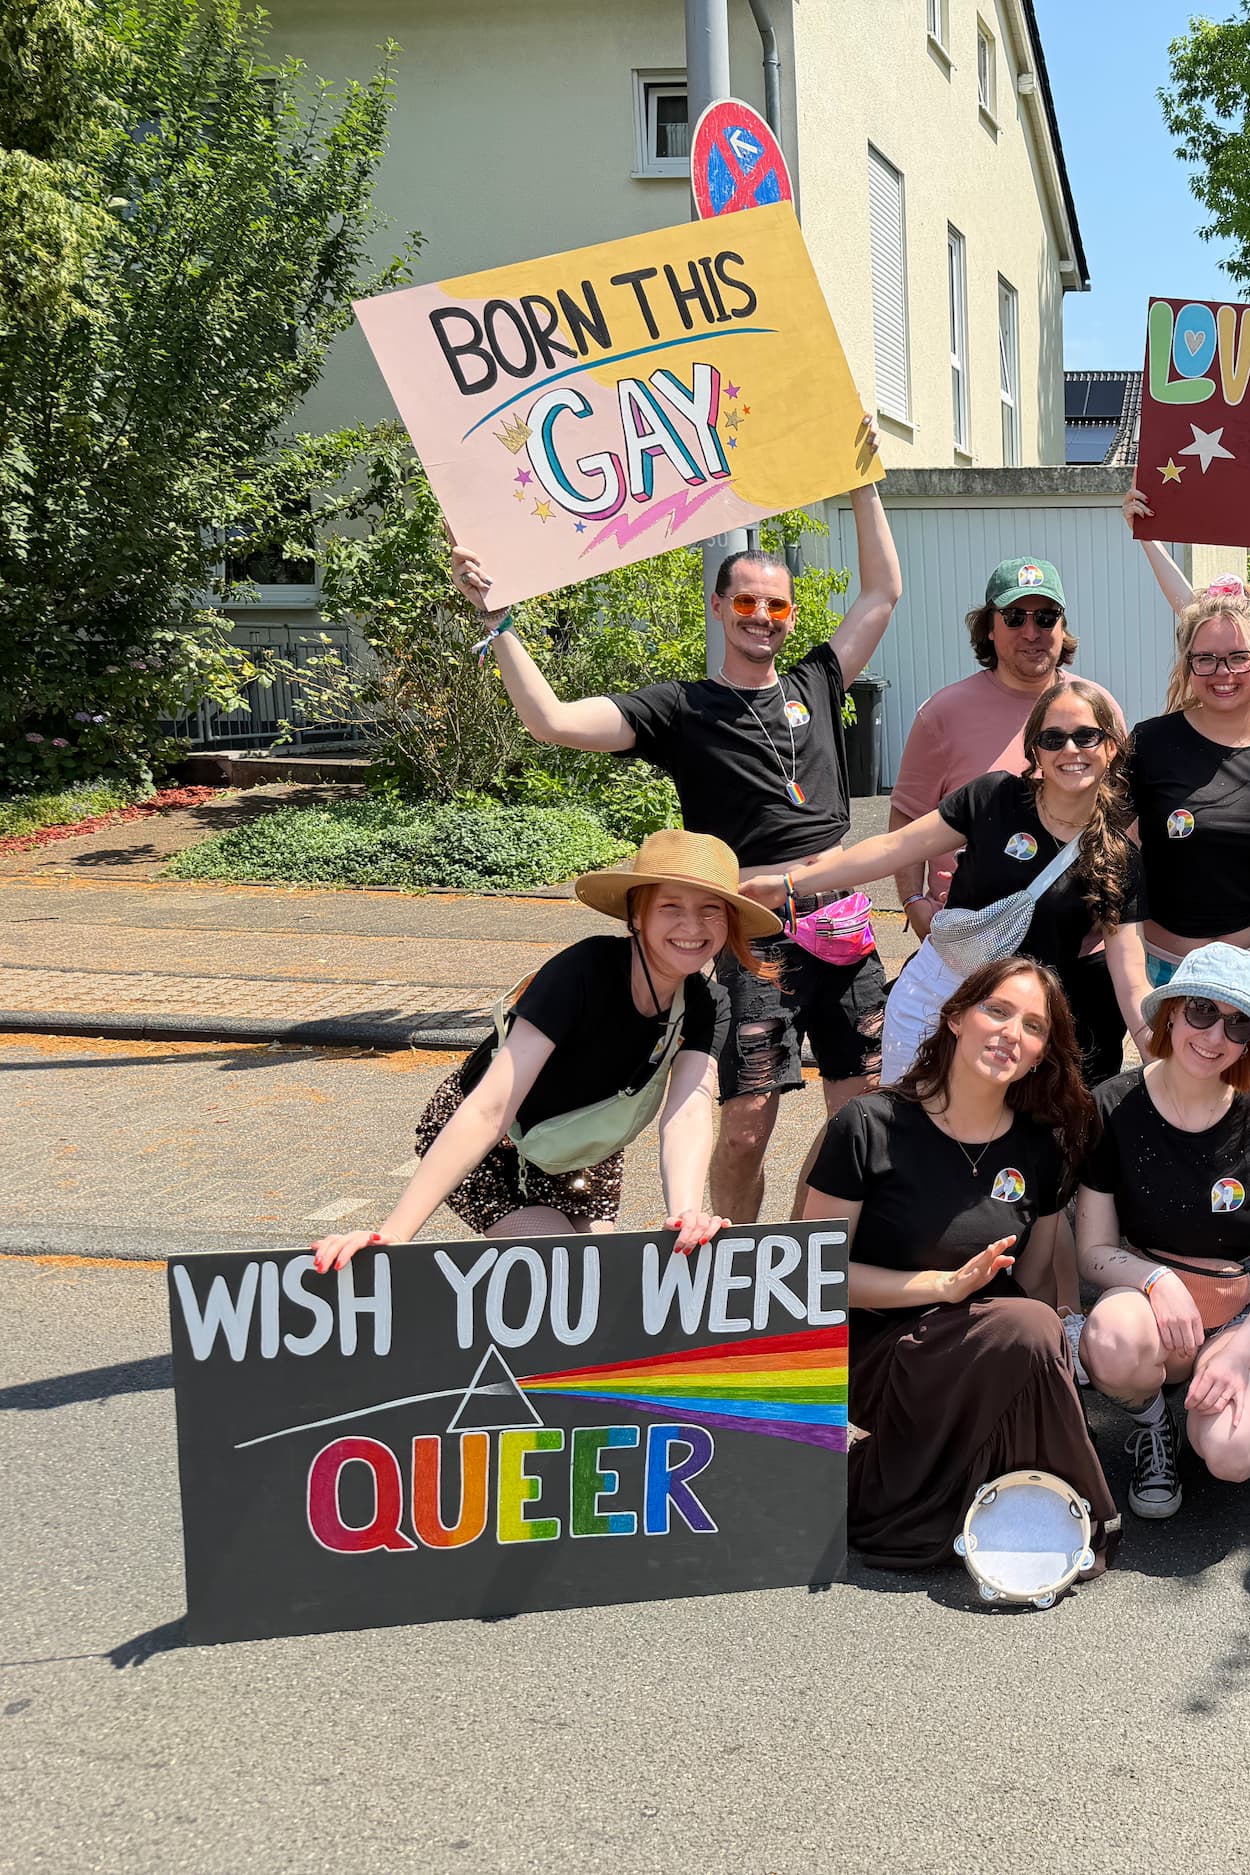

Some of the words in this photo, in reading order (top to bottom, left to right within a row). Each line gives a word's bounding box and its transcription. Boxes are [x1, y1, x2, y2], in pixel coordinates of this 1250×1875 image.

[429, 280, 612, 396] BORN
[610, 251, 757, 340] THIS
[526, 362, 731, 521] GAY
[173, 1252, 392, 1362] WISH
[434, 1246, 600, 1350] YOU
[642, 1232, 847, 1336] WERE
[306, 1423, 719, 1553] QUEER
